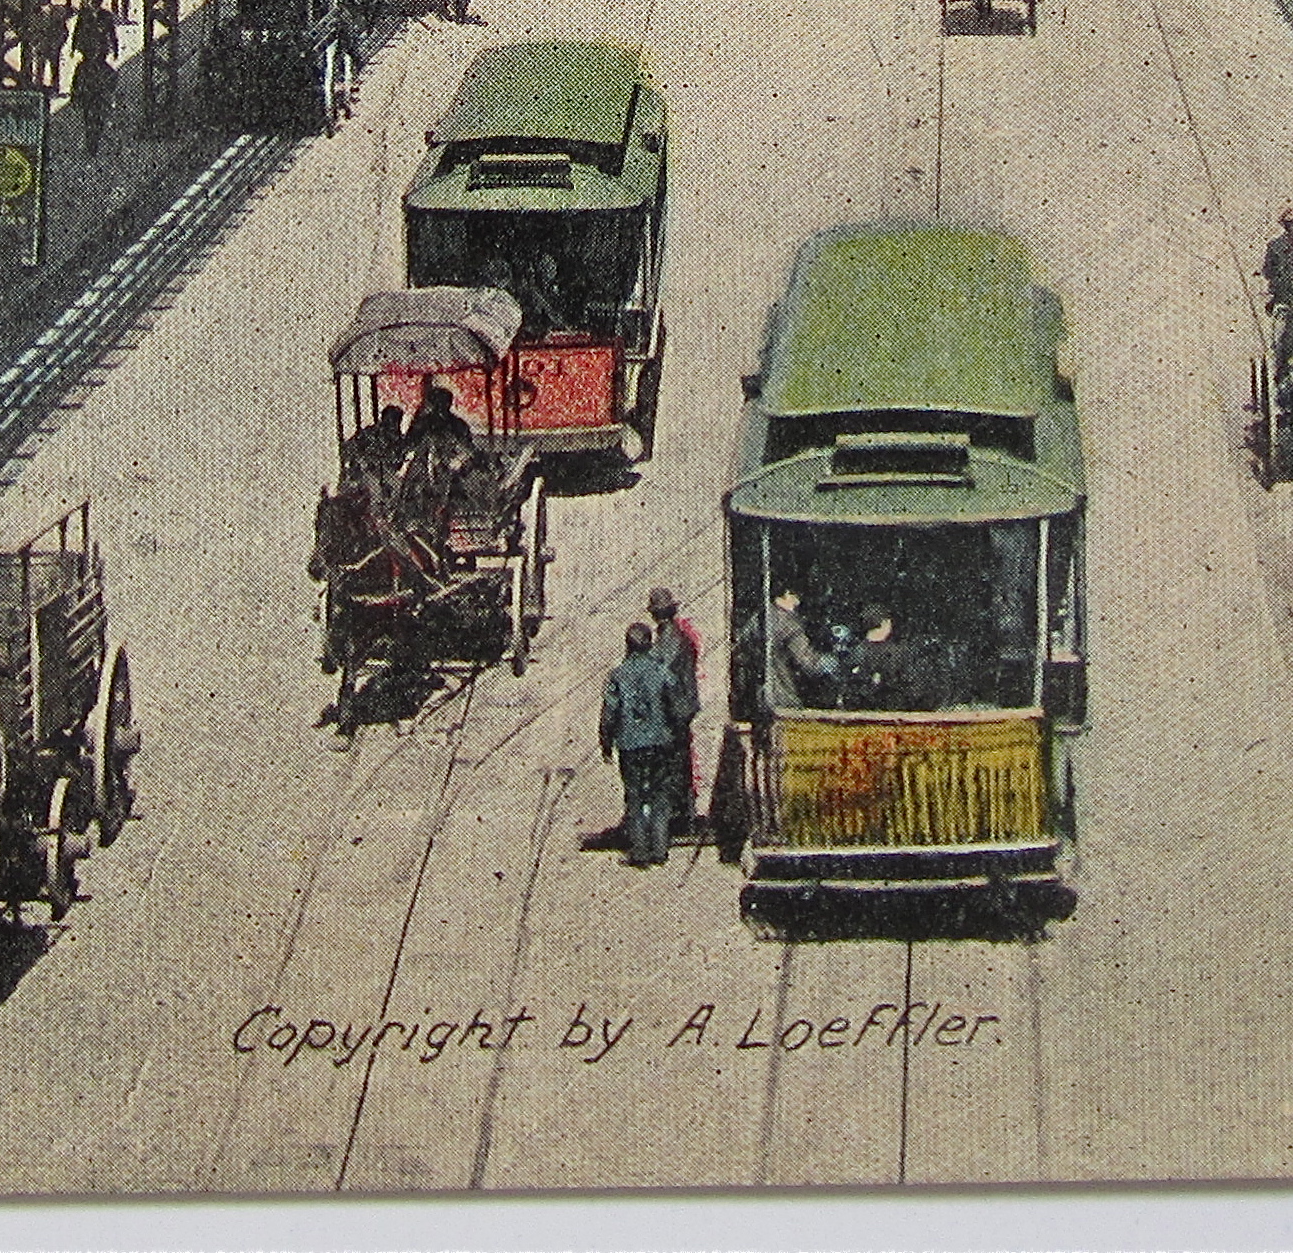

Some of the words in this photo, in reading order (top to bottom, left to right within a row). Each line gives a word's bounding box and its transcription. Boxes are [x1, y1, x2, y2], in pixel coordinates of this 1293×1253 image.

[231, 1003, 540, 1068] Copyright
[560, 1002, 635, 1064] by
[665, 1003, 722, 1050] A.
[736, 1002, 1005, 1051] Loeffler.
